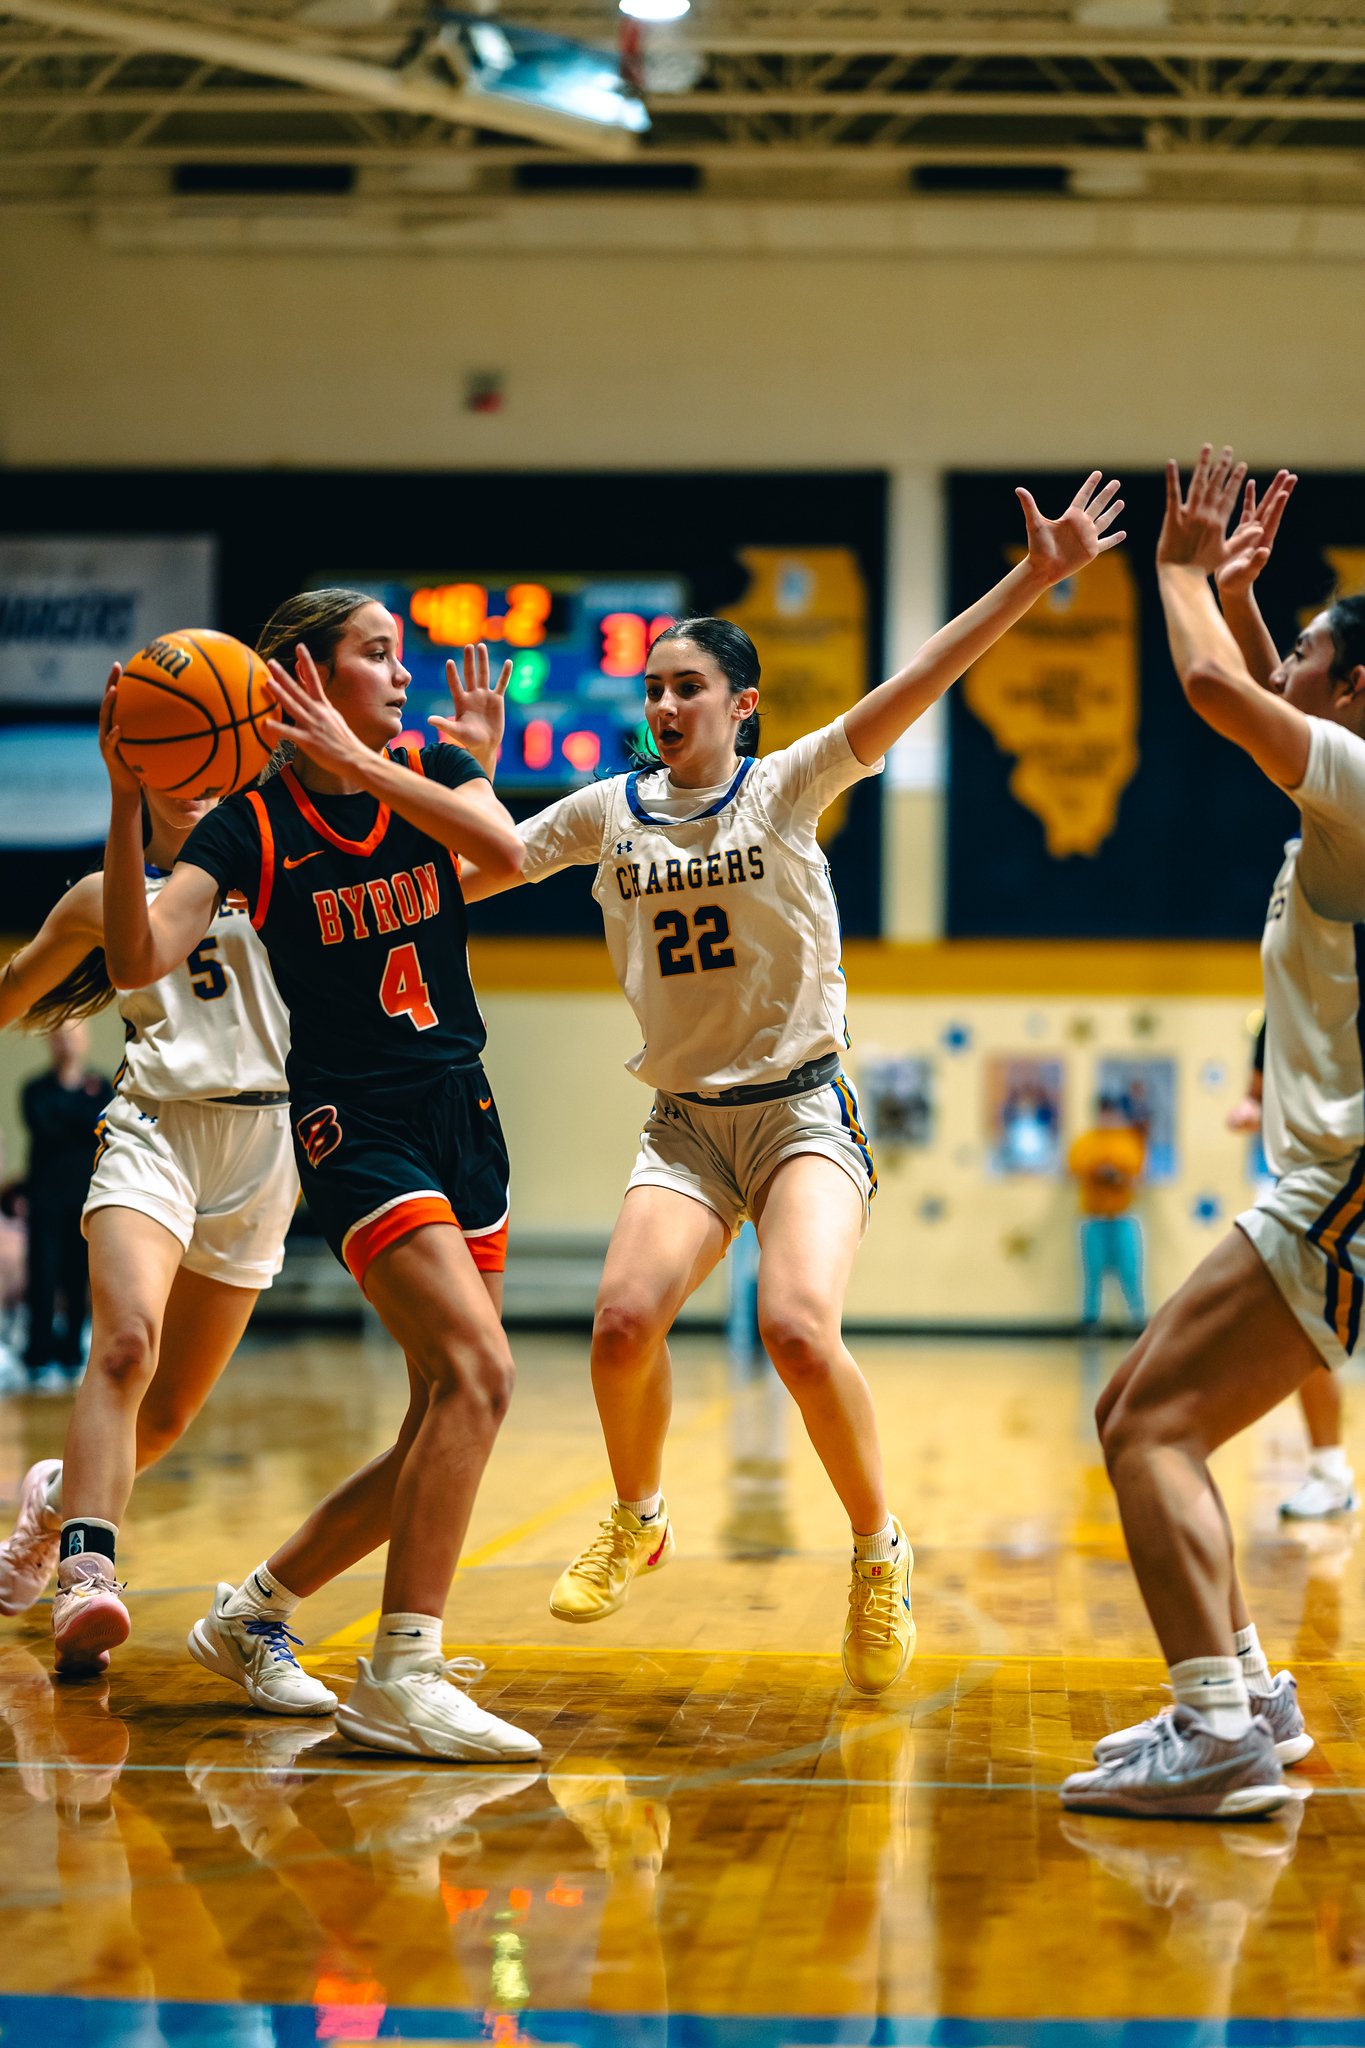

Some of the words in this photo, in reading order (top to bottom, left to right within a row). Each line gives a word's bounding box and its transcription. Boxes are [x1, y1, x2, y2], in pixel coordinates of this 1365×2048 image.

[312, 861, 440, 945] BYRON
[616, 845, 765, 900] CHARGERS
[186, 935, 229, 1002] 5
[652, 904, 737, 978] 22
[379, 941, 439, 1032] 4
